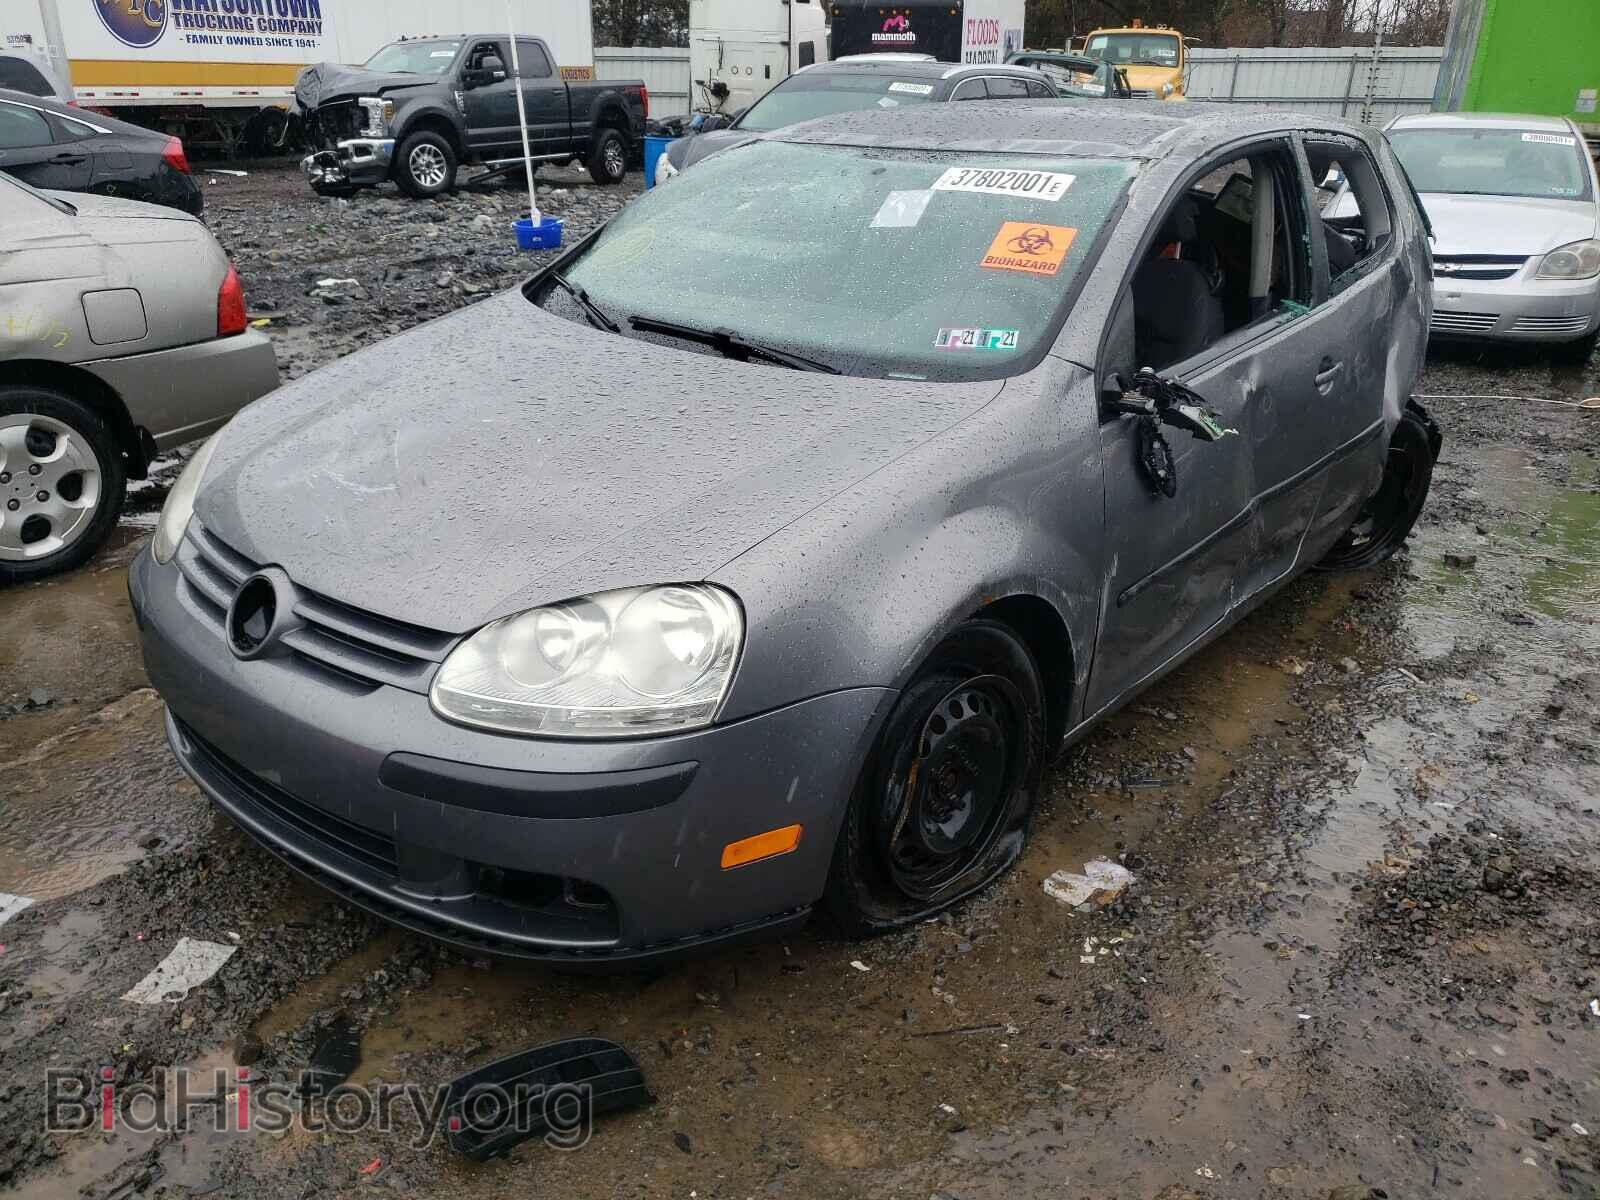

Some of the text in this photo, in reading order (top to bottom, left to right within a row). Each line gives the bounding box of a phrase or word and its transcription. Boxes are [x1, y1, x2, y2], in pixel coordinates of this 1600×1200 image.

[172, 13, 254, 31] TRUCKING
[257, 17, 323, 34] COMPANY
[871, 31, 916, 41] mammoth
[966, 18, 999, 46] FLOODS
[186, 34, 316, 49] FAMILY OWNED SINCE 1941
[560, 68, 591, 80] LOGISTICS
[951, 169, 1062, 194] 37802001 E
[984, 255, 1057, 272] BIOHAZARD
[962, 330, 975, 345] 21
[1002, 331, 1015, 346] 21
